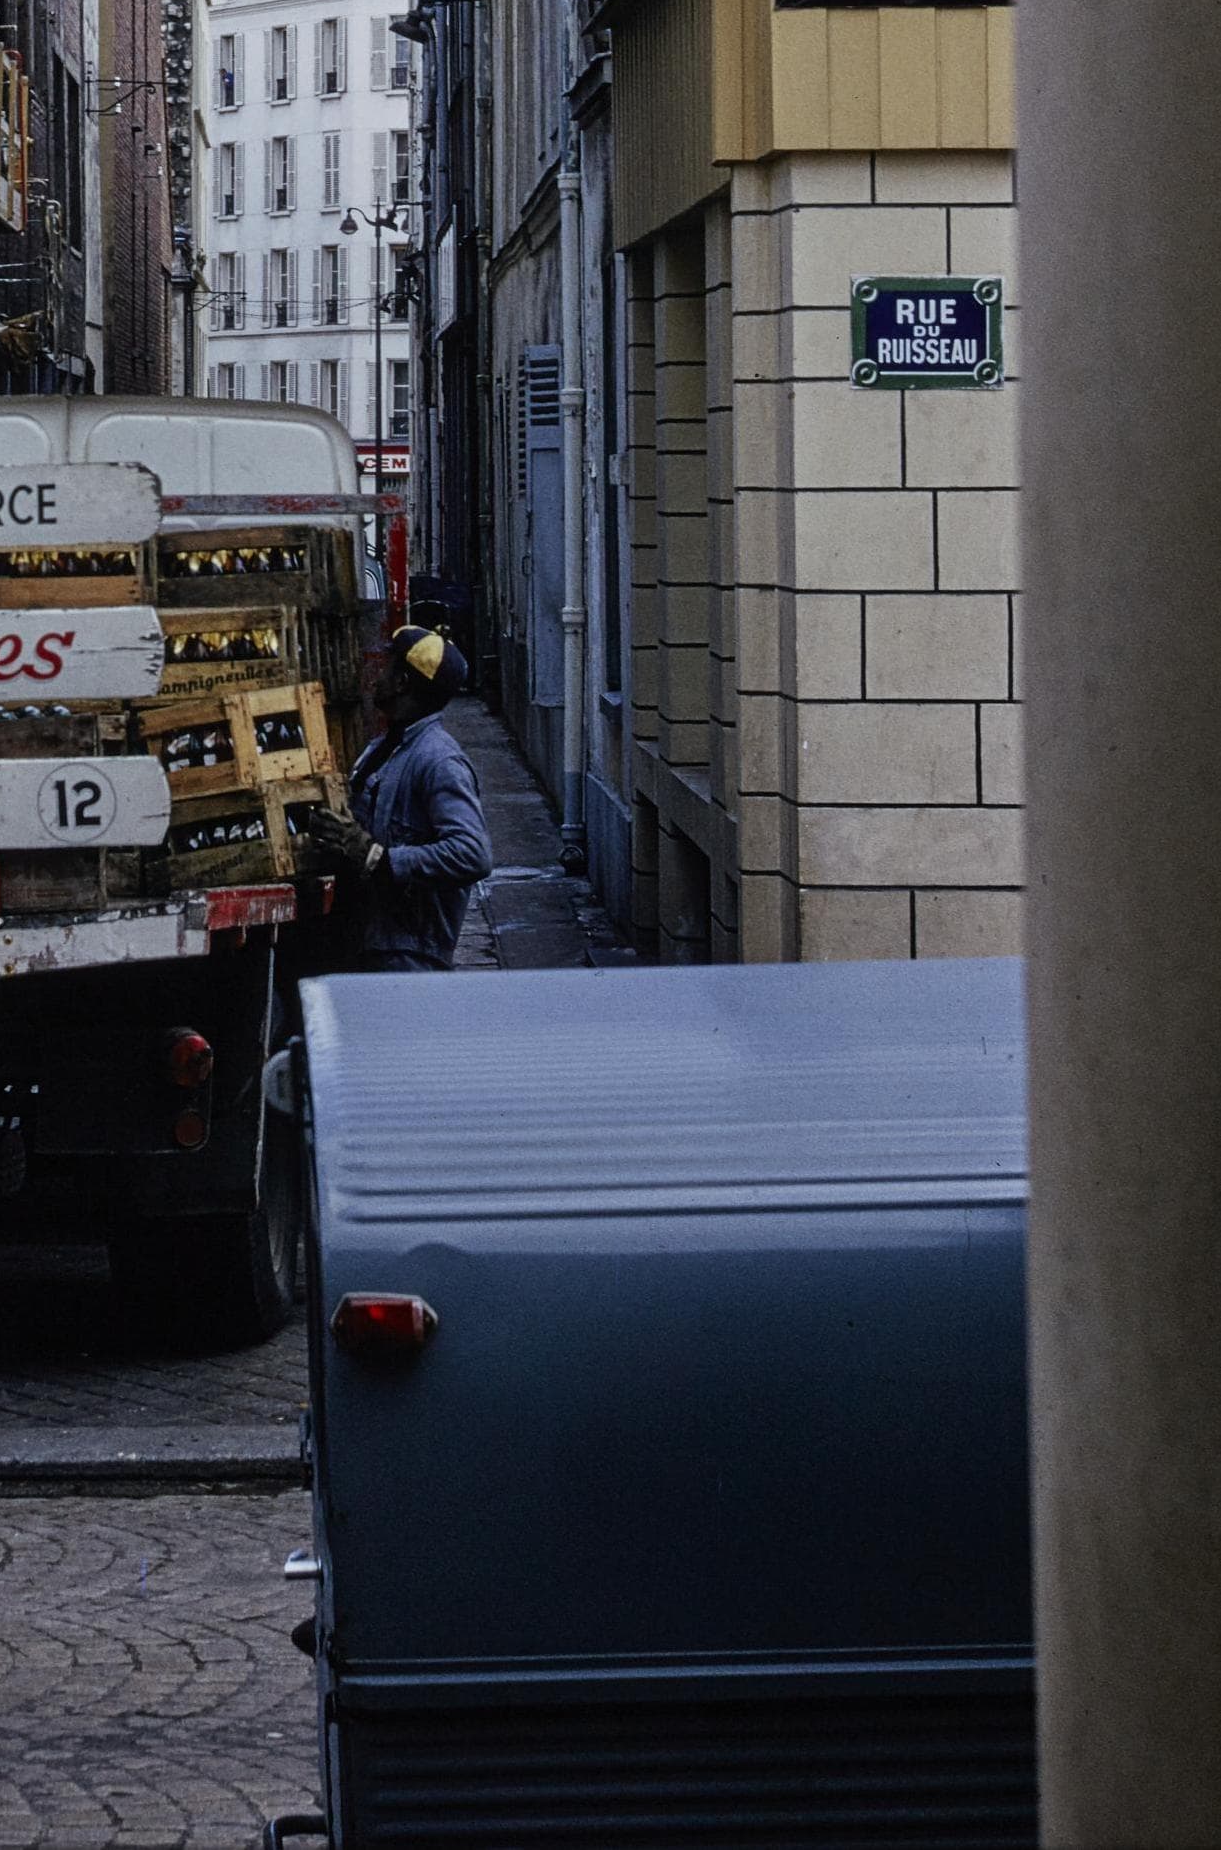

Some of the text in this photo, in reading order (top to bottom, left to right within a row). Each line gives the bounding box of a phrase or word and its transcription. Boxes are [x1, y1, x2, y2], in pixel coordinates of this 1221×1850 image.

[896, 299, 957, 324] RUE
[913, 325, 940, 337] DU
[877, 338, 978, 364] RUISSEAU
[53, 779, 102, 827] 12
